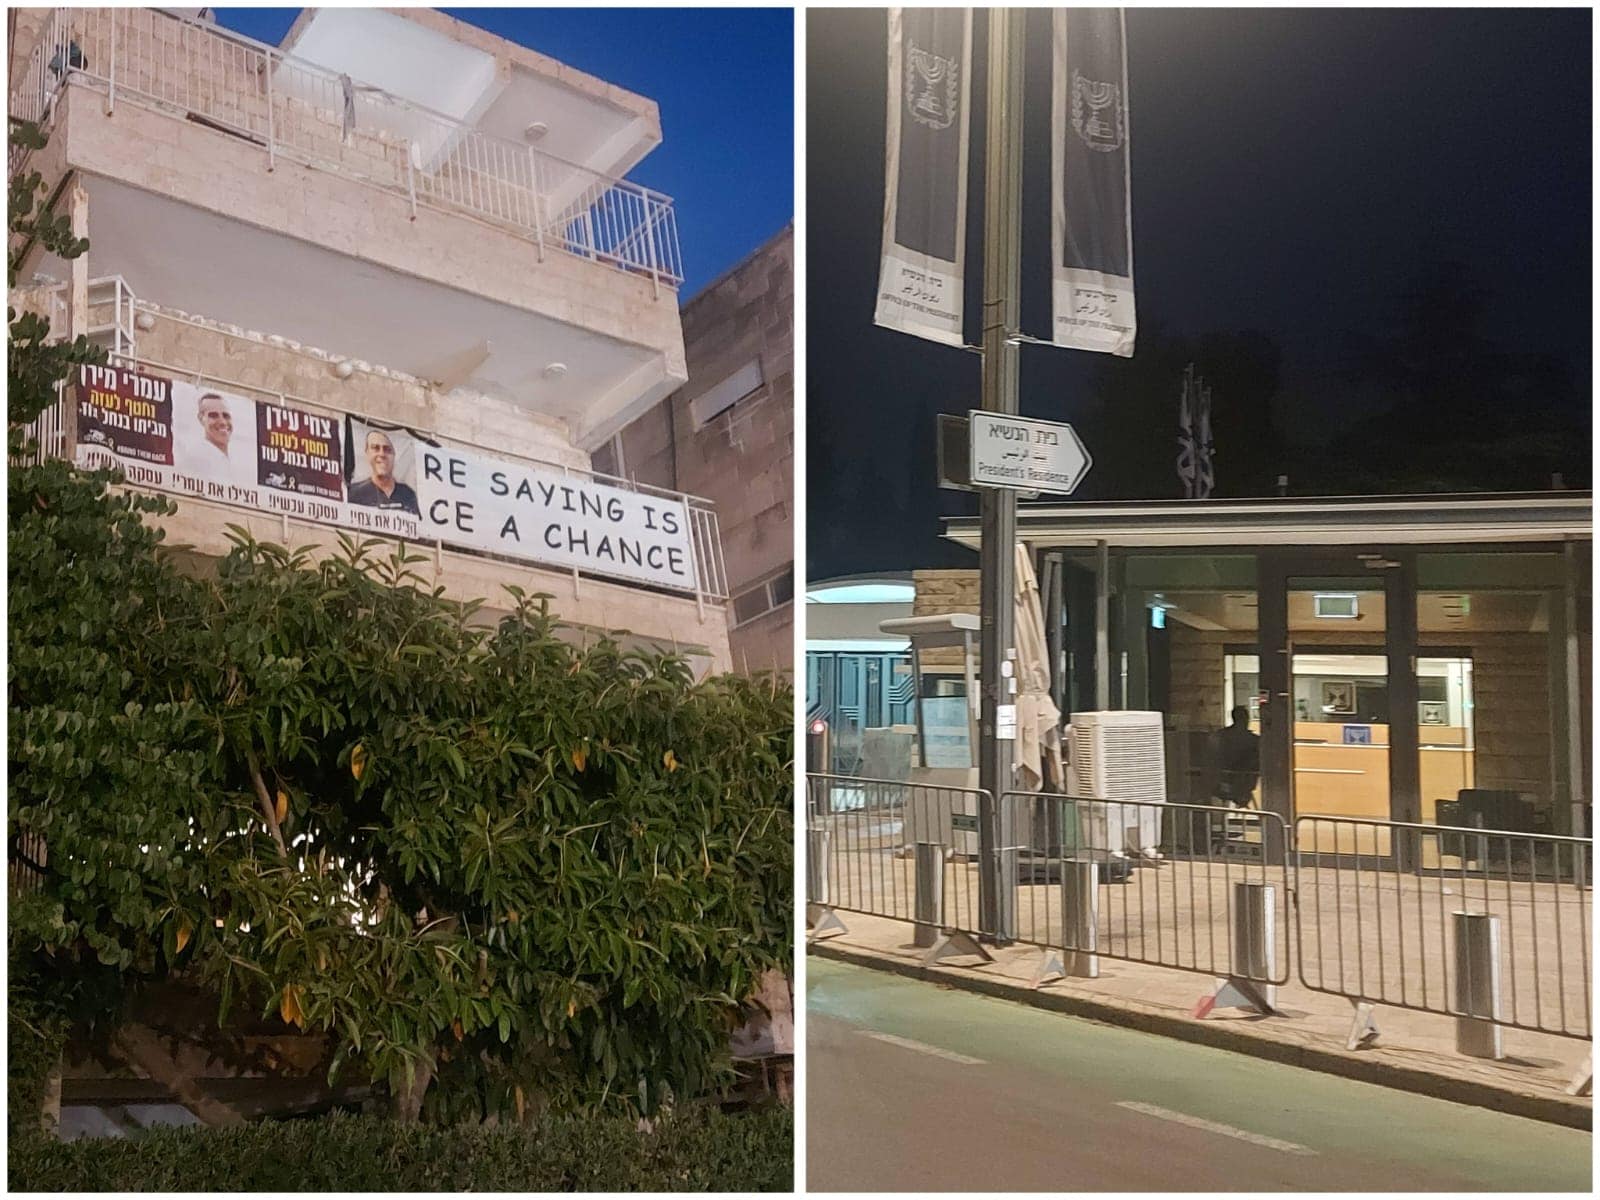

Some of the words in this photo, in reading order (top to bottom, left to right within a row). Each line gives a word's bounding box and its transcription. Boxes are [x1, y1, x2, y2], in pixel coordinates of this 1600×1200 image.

[80, 363, 117, 391] מירן
[123, 371, 166, 403] עמרי
[90, 388, 121, 412] לעזה
[125, 397, 157, 419] נחטף
[101, 407, 131, 432] בנחל
[134, 416, 168, 439] מביתו
[266, 405, 299, 432] עידן
[303, 414, 332, 439] צחי
[270, 431, 299, 450] לעזה
[989, 423, 1030, 443] הנשיא
[1035, 430, 1059, 446] בית
[261, 444, 279, 462] עוז
[301, 438, 329, 458] נחטף
[281, 449, 308, 469] בנחל
[311, 458, 340, 476] מביתו
[128, 466, 163, 485] עסקה
[978, 461, 1025, 480] President's
[1028, 466, 1069, 484] Residence
[208, 483, 225, 497] את
[228, 486, 258, 505] הצילו
[424, 453, 466, 488] RE
[489, 471, 625, 523] SAYING
[642, 505, 680, 535] IS
[308, 501, 339, 521] עסקה
[374, 513, 391, 530] את
[392, 515, 418, 538] הצילו
[417, 499, 474, 533] CE
[500, 515, 520, 542] A
[544, 523, 685, 576] CHANCE
